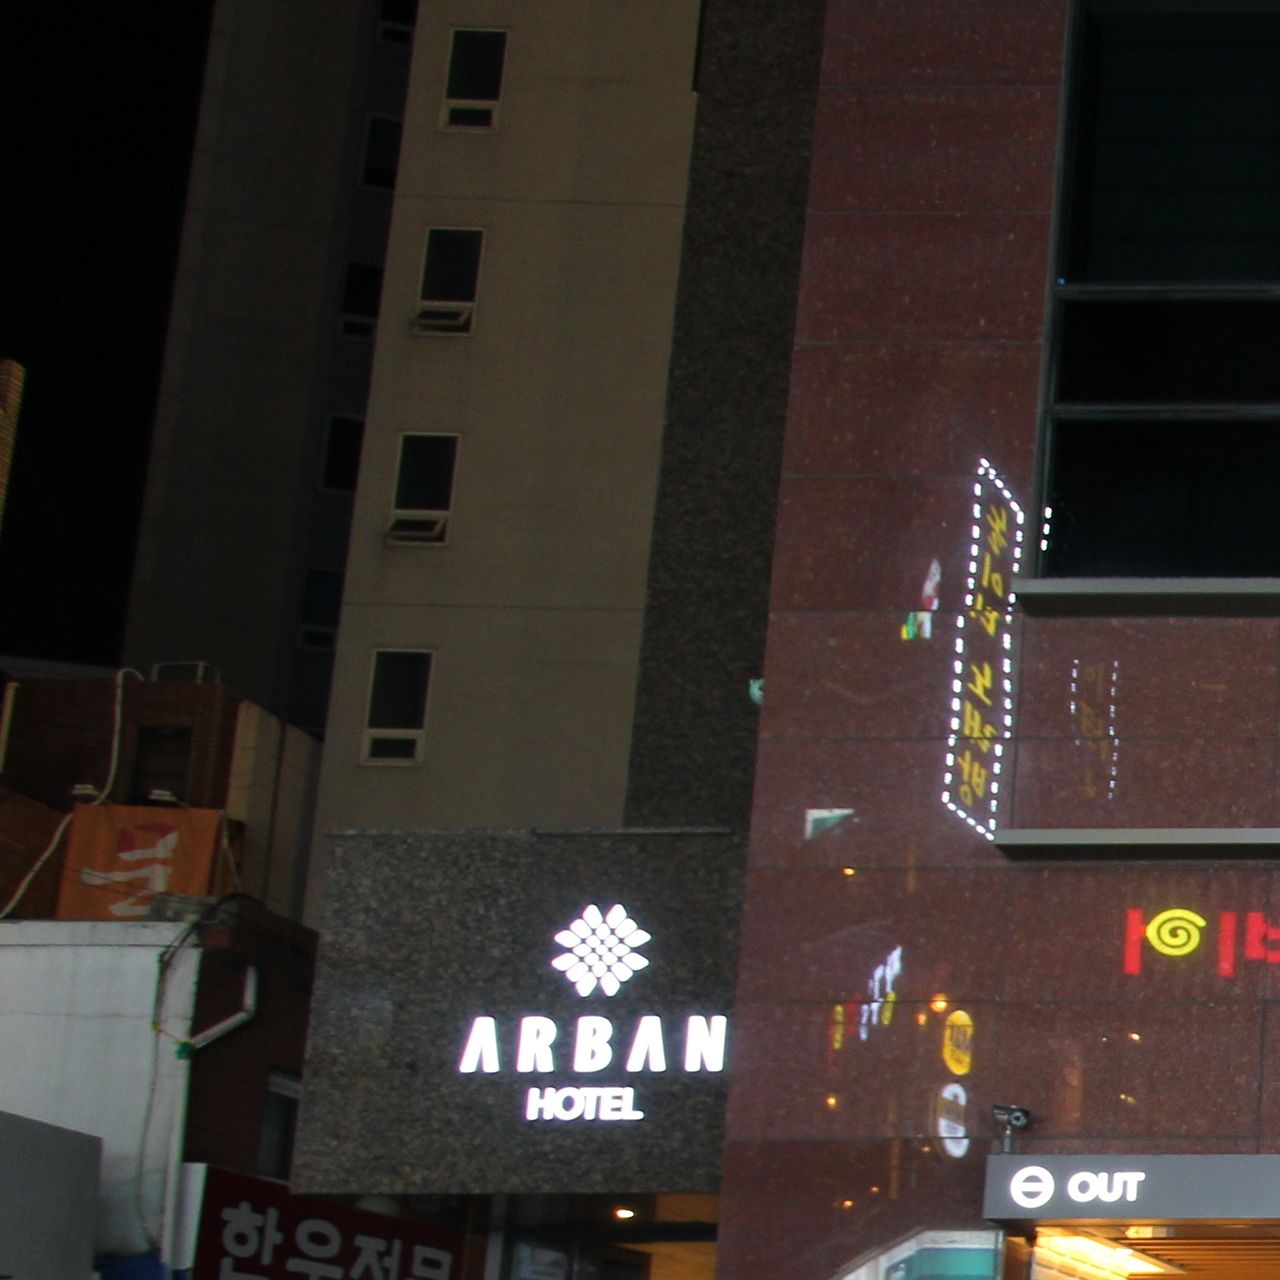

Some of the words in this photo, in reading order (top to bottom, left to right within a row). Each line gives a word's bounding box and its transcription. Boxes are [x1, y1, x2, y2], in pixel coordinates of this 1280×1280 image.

[459, 1015, 728, 1073] ARBAN
[526, 1086, 645, 1121] HOTEL
[1067, 1171, 1146, 1203] OUT
